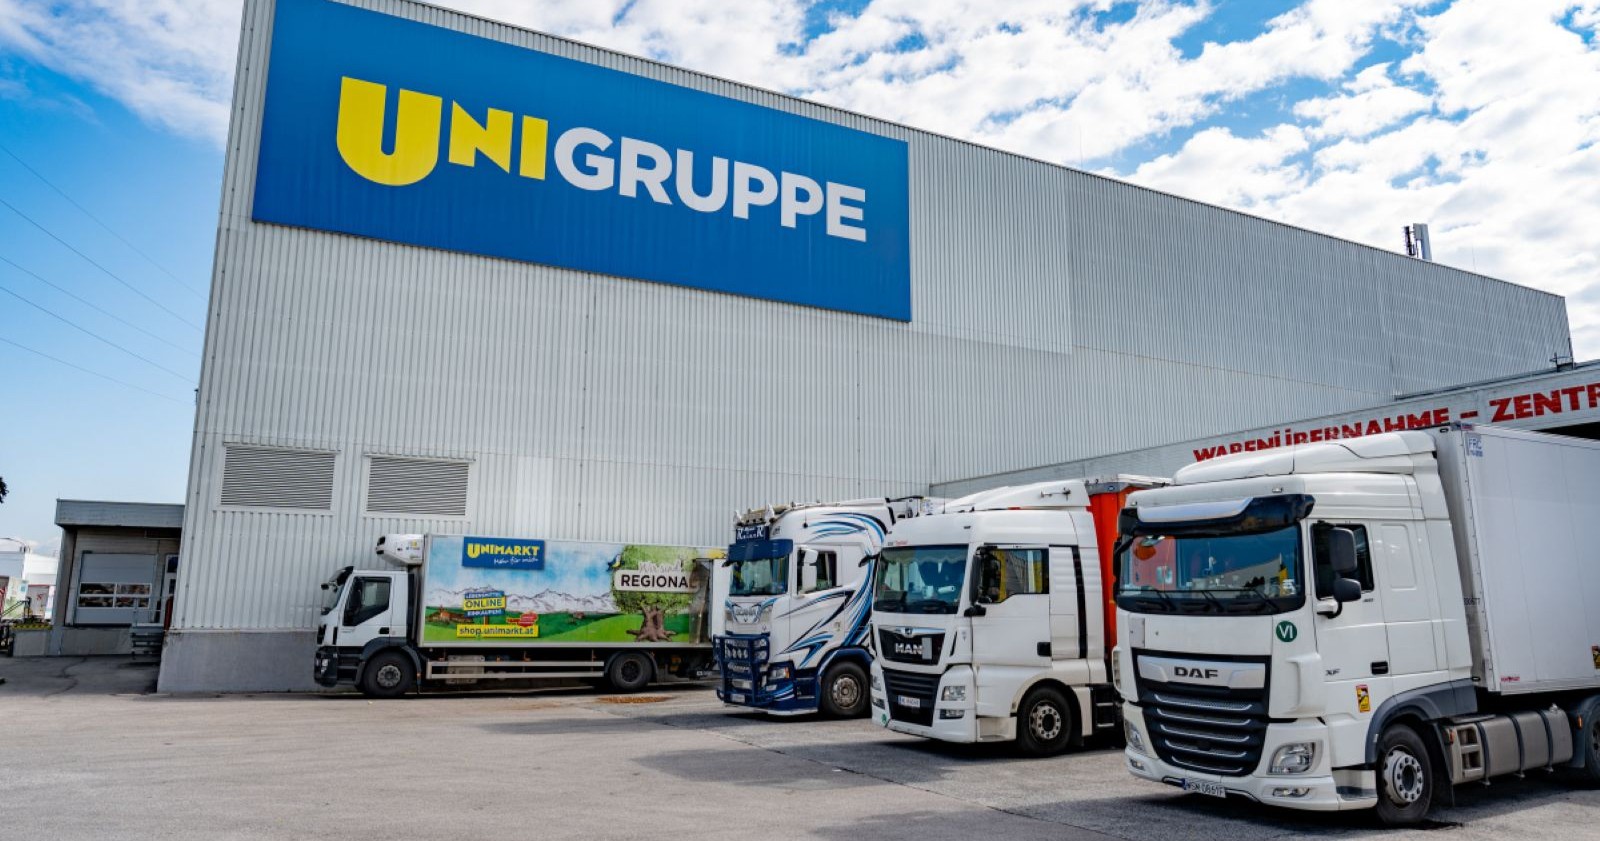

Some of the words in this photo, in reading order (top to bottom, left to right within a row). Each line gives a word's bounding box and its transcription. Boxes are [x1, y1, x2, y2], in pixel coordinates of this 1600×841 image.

[336, 76, 866, 242] UNIGRUPPE
[467, 543, 540, 558] UNIMARKT
[465, 598, 502, 608] ONLINE
[460, 627, 533, 636] shop.unimarkt.at
[1279, 625, 1294, 639] VI
[895, 642, 923, 655] MAN
[1174, 666, 1218, 679] DAF
